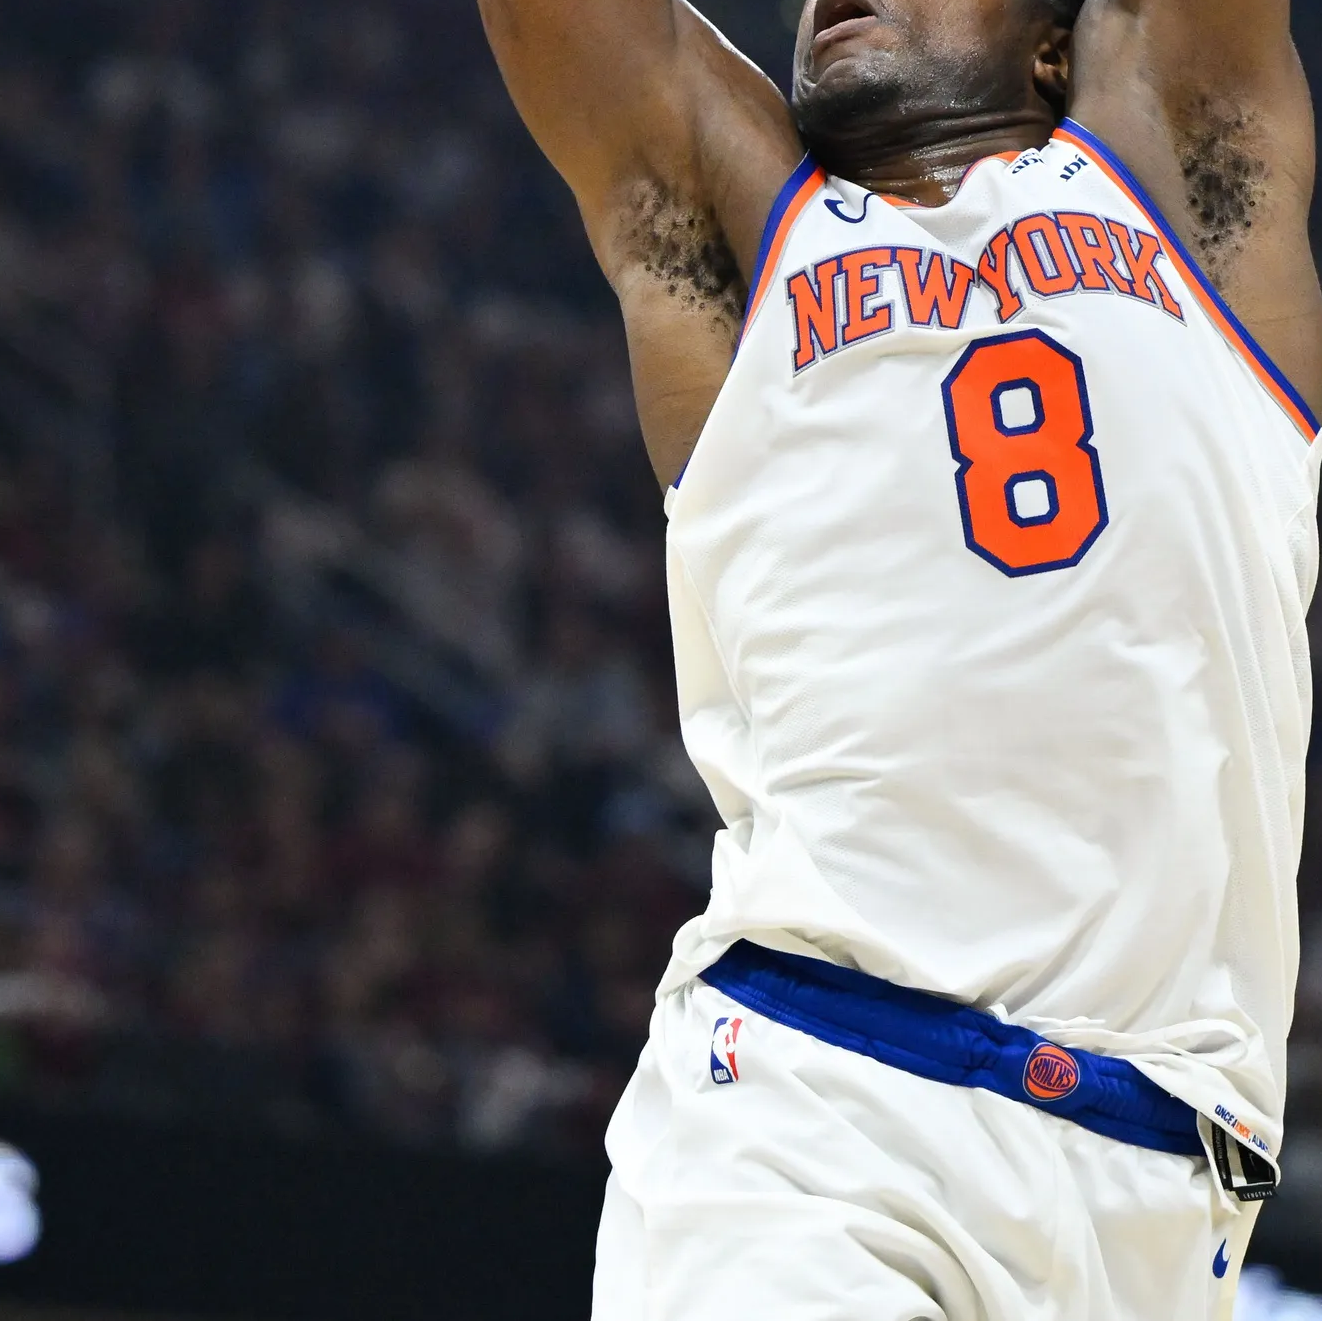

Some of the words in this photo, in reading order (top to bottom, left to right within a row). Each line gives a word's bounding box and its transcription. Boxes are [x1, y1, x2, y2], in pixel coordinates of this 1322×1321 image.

[786, 244, 980, 377] NEW
[978, 208, 1188, 327] YORK
[941, 328, 1109, 578] 8
[713, 1068, 730, 1082] NBA
[1031, 1057, 1075, 1089] KNICKS
[1214, 1104, 1235, 1125] ONCE
